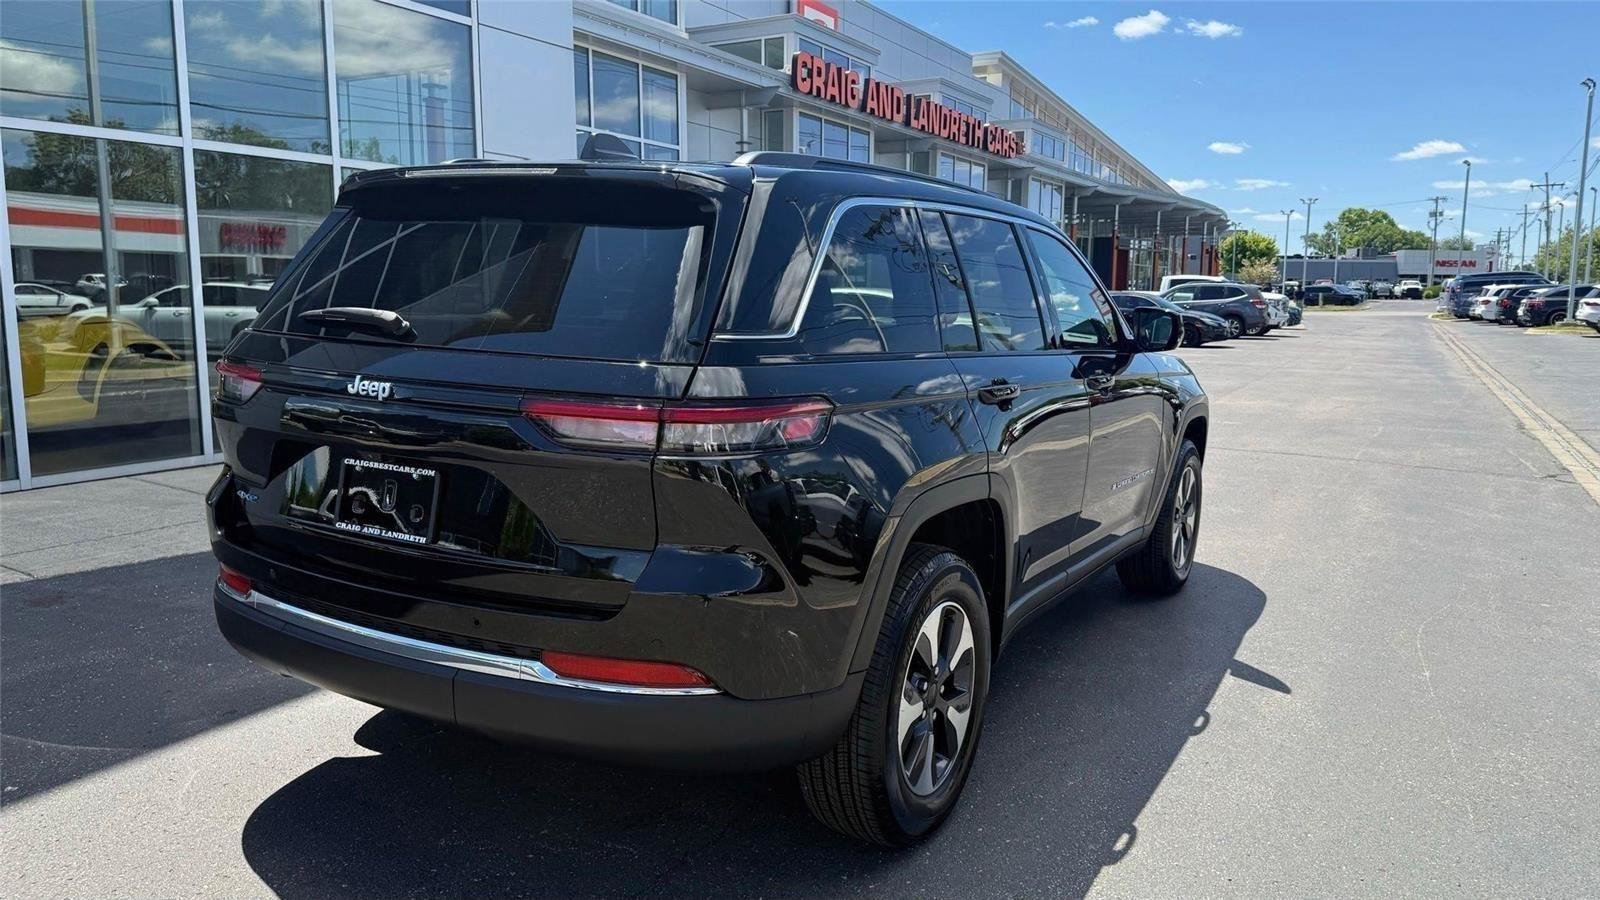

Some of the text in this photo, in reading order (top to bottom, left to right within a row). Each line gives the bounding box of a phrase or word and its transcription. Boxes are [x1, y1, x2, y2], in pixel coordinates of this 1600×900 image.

[793, 51, 1017, 159] CRAIG AND LANDRETH CARS
[1435, 259, 1477, 268] NISSAN
[347, 374, 392, 401] Jeep
[344, 458, 436, 477] CRAIGSBESTCARS.COM
[335, 522, 427, 544] CRAIG AND LANDRETH
